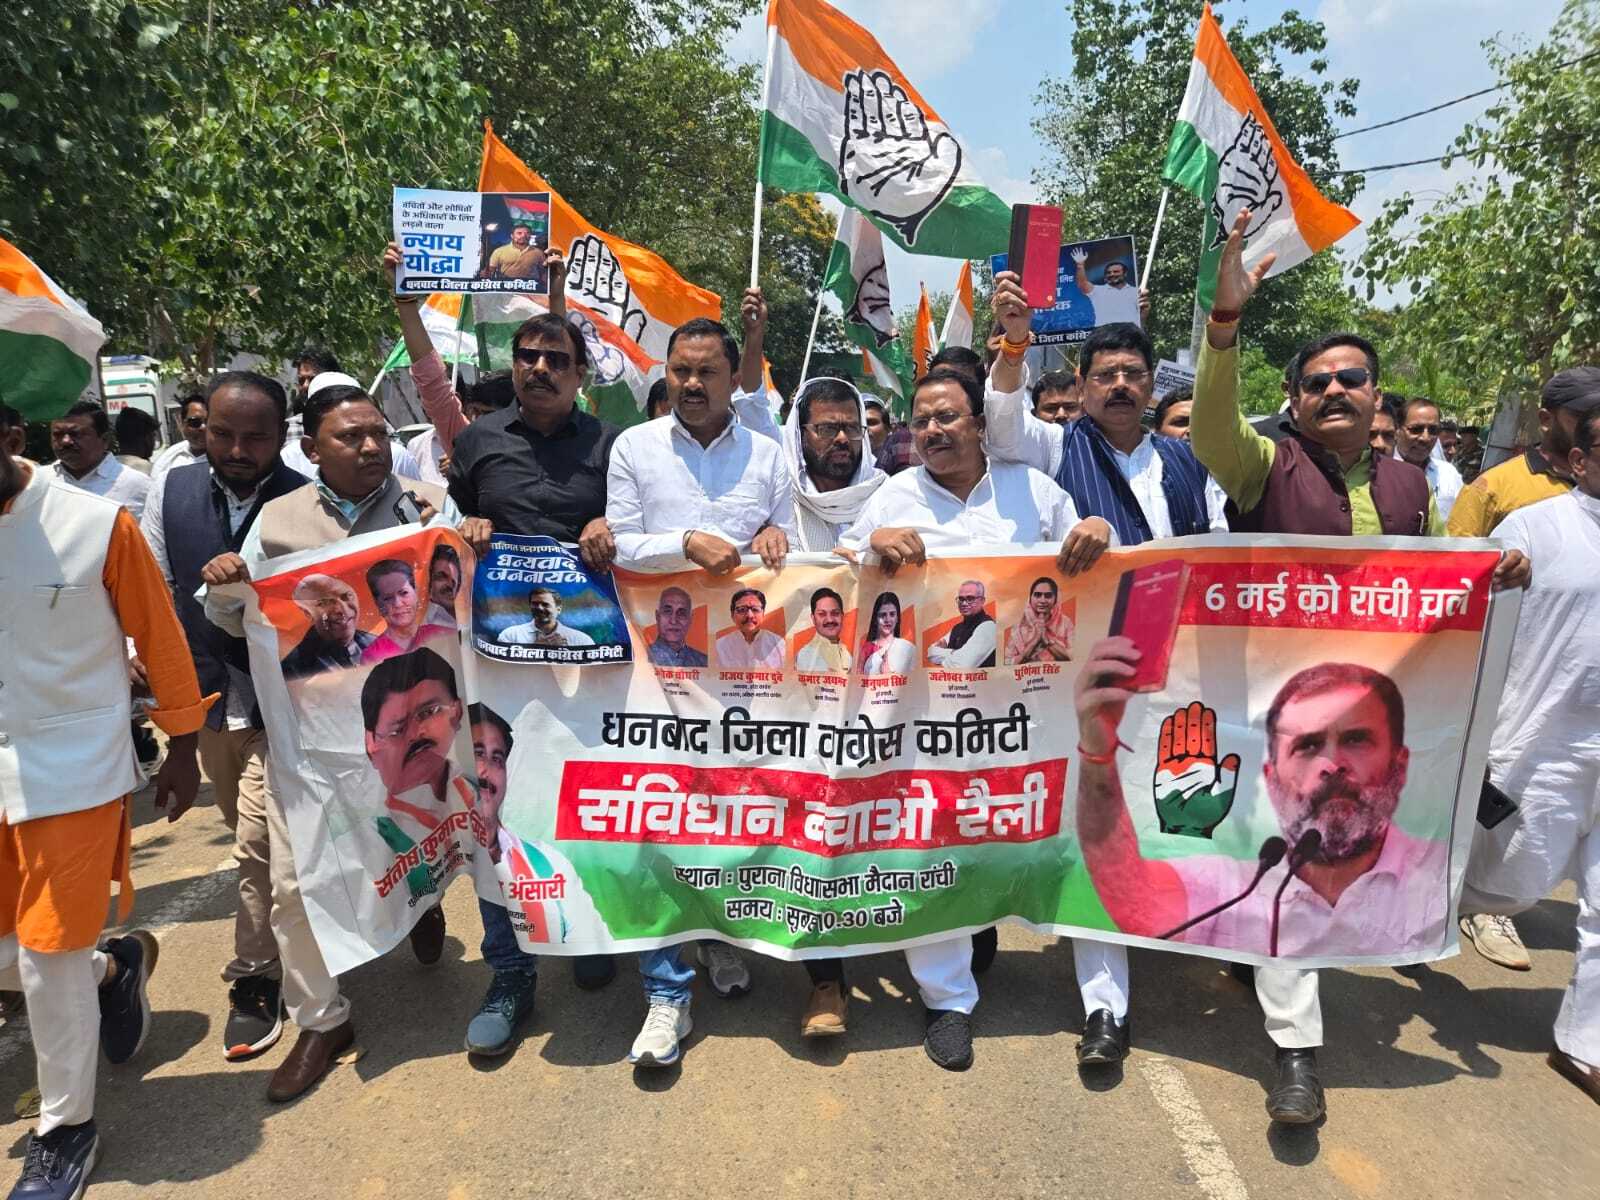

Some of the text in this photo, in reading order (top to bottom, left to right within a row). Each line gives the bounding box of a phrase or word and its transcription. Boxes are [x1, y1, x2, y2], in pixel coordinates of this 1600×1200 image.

[428, 202, 443, 211] और
[402, 210, 410, 218] के
[449, 213, 457, 221] के
[459, 213, 475, 222] लिए
[425, 222, 444, 230] वाला
[401, 232, 465, 251] न्याय
[403, 250, 463, 274] योद्धा
[440, 278, 469, 290] जिला
[471, 278, 501, 290] कांग्रेस
[503, 278, 538, 291] कमिटी
[1039, 334, 1063, 344] जिला
[497, 554, 577, 570] धन्यवाद
[487, 567, 588, 584] जननायक
[1205, 583, 1225, 611] 6
[1236, 572, 1290, 618] मई
[1297, 574, 1342, 615] को
[1350, 577, 1413, 618] रांची
[509, 645, 544, 659] जिला
[547, 646, 584, 661] कांग्रेस
[586, 646, 624, 659] कमिटी
[719, 671, 744, 681] अजय
[745, 671, 769, 684] कुमार
[601, 702, 1031, 768] धनबाद जिला कांग्रेस कमिटी
[577, 771, 1049, 848] संविधान बचाओ रैली
[373, 847, 420, 898] संतोष
[420, 811, 469, 862] कुमार
[673, 865, 721, 889] स्थान
[738, 866, 786, 892] पुराना
[864, 865, 914, 893] मैदान
[920, 861, 956, 889] रांची
[508, 873, 567, 901] अंसारी
[726, 898, 773, 920] समय
[873, 897, 904, 926] बजे
